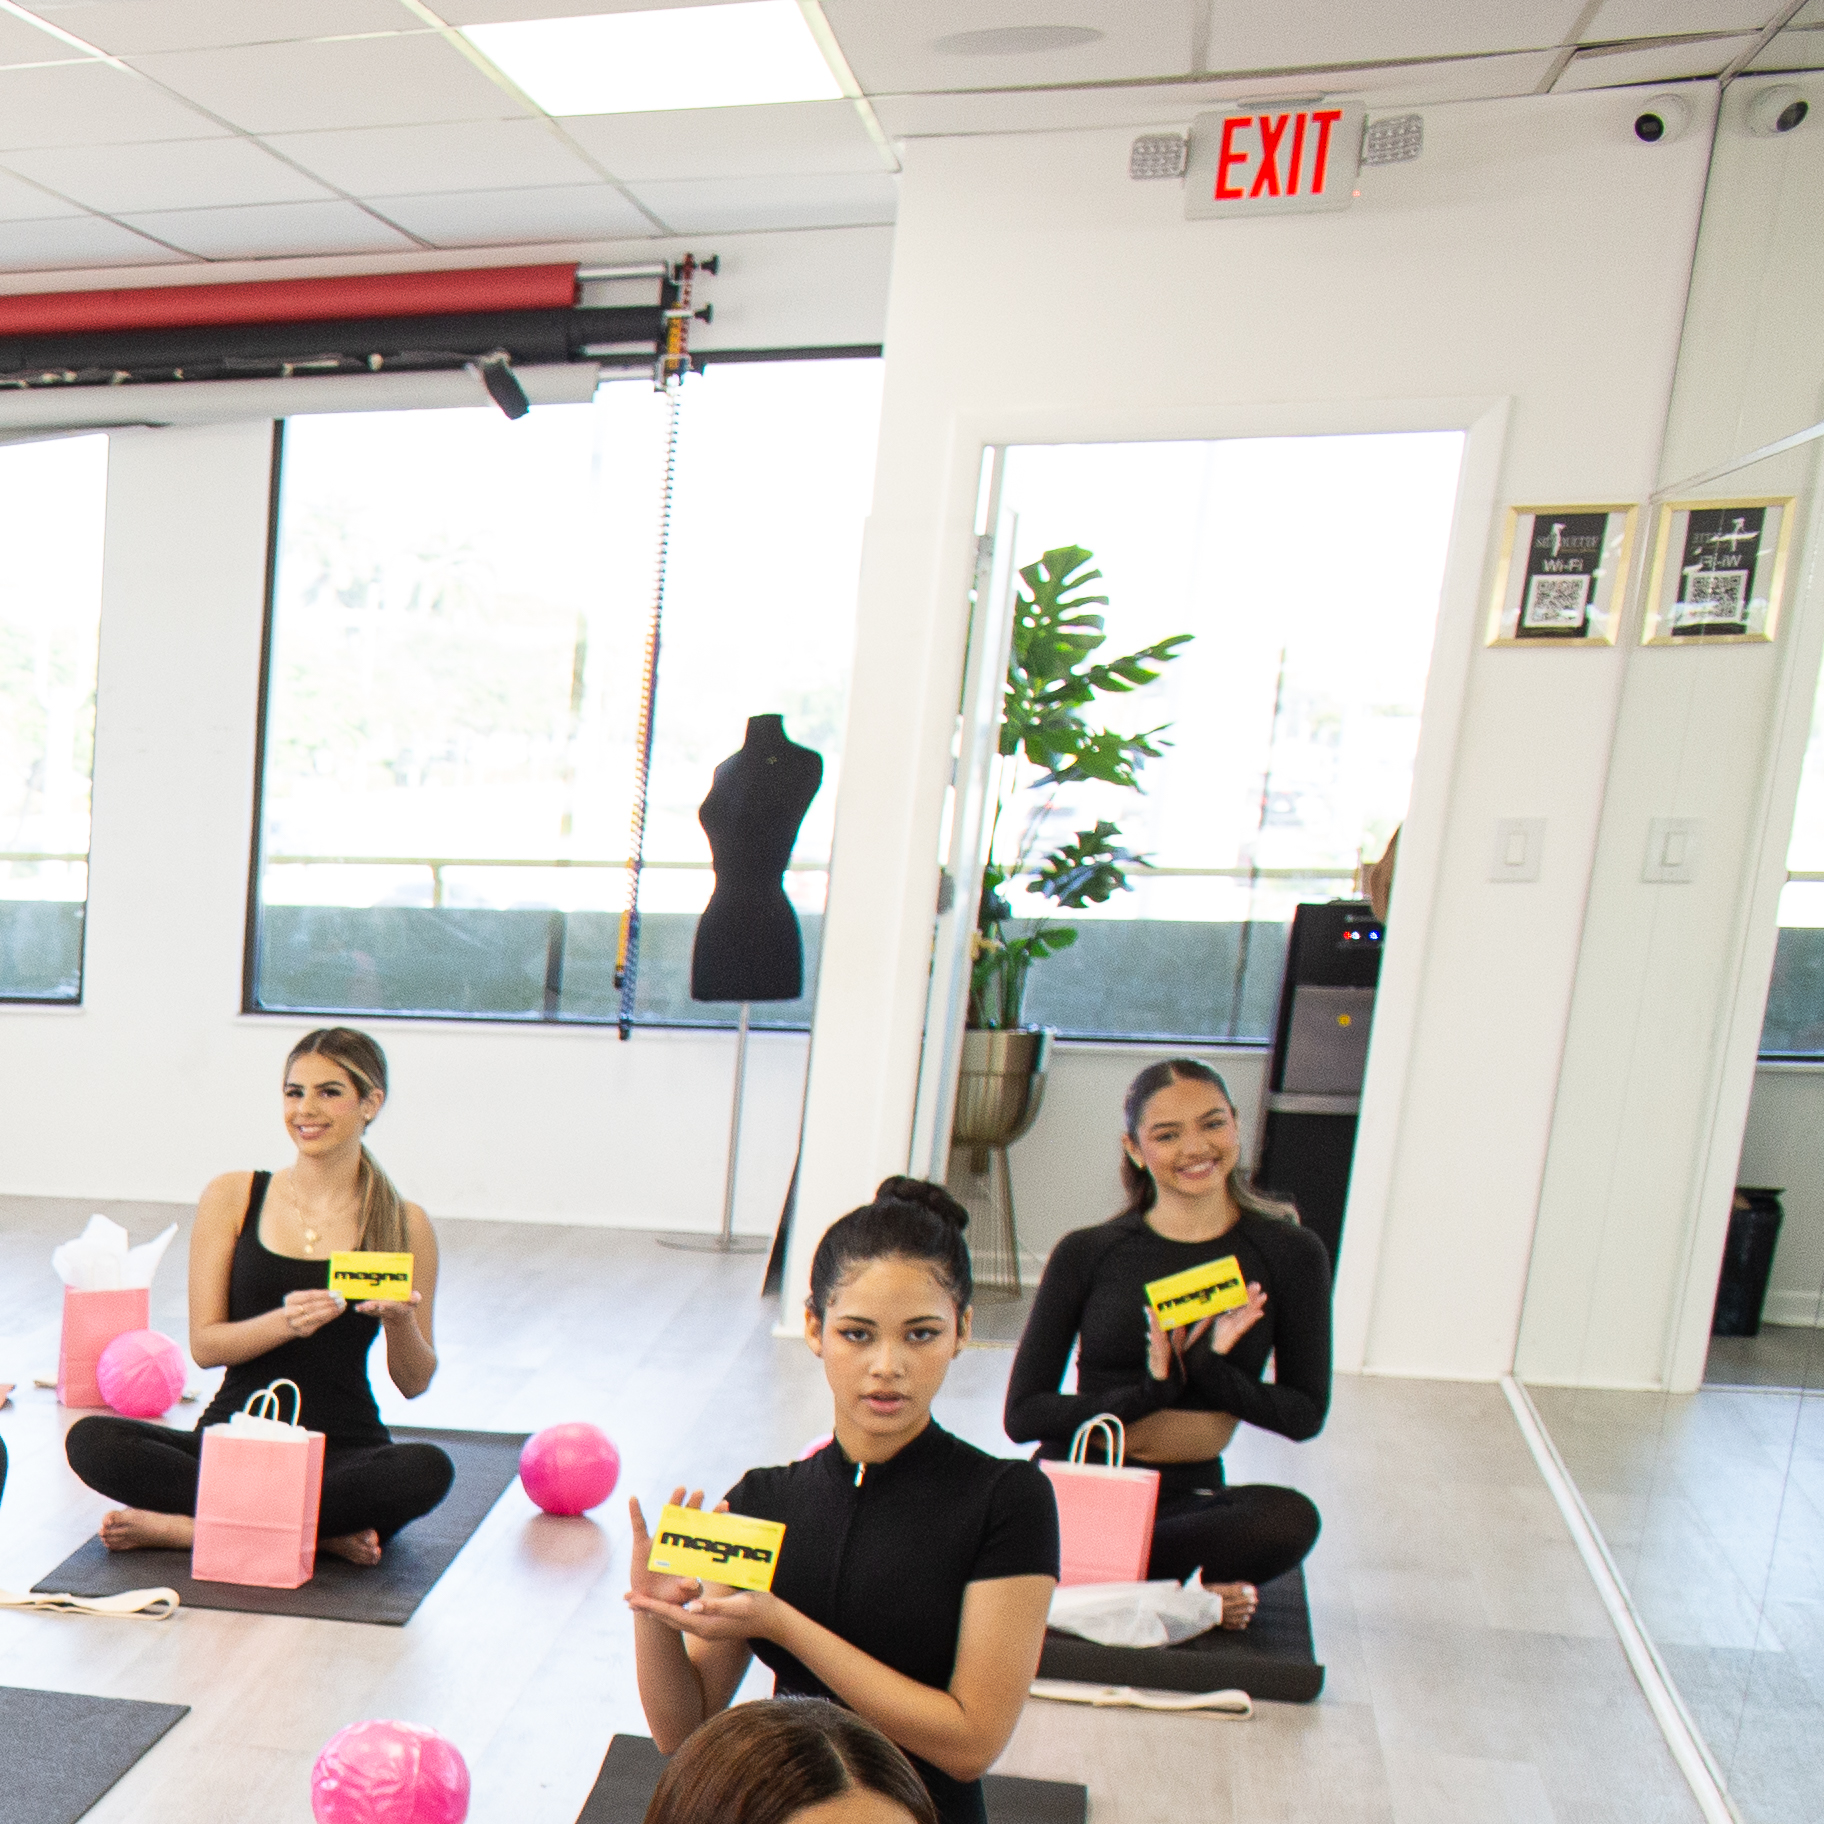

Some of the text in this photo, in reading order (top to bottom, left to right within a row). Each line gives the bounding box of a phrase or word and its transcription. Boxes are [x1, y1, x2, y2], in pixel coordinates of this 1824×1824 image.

[1214, 109, 1343, 201] EXIT
[334, 1271, 408, 1286] magna
[660, 1532, 773, 1563] magna
